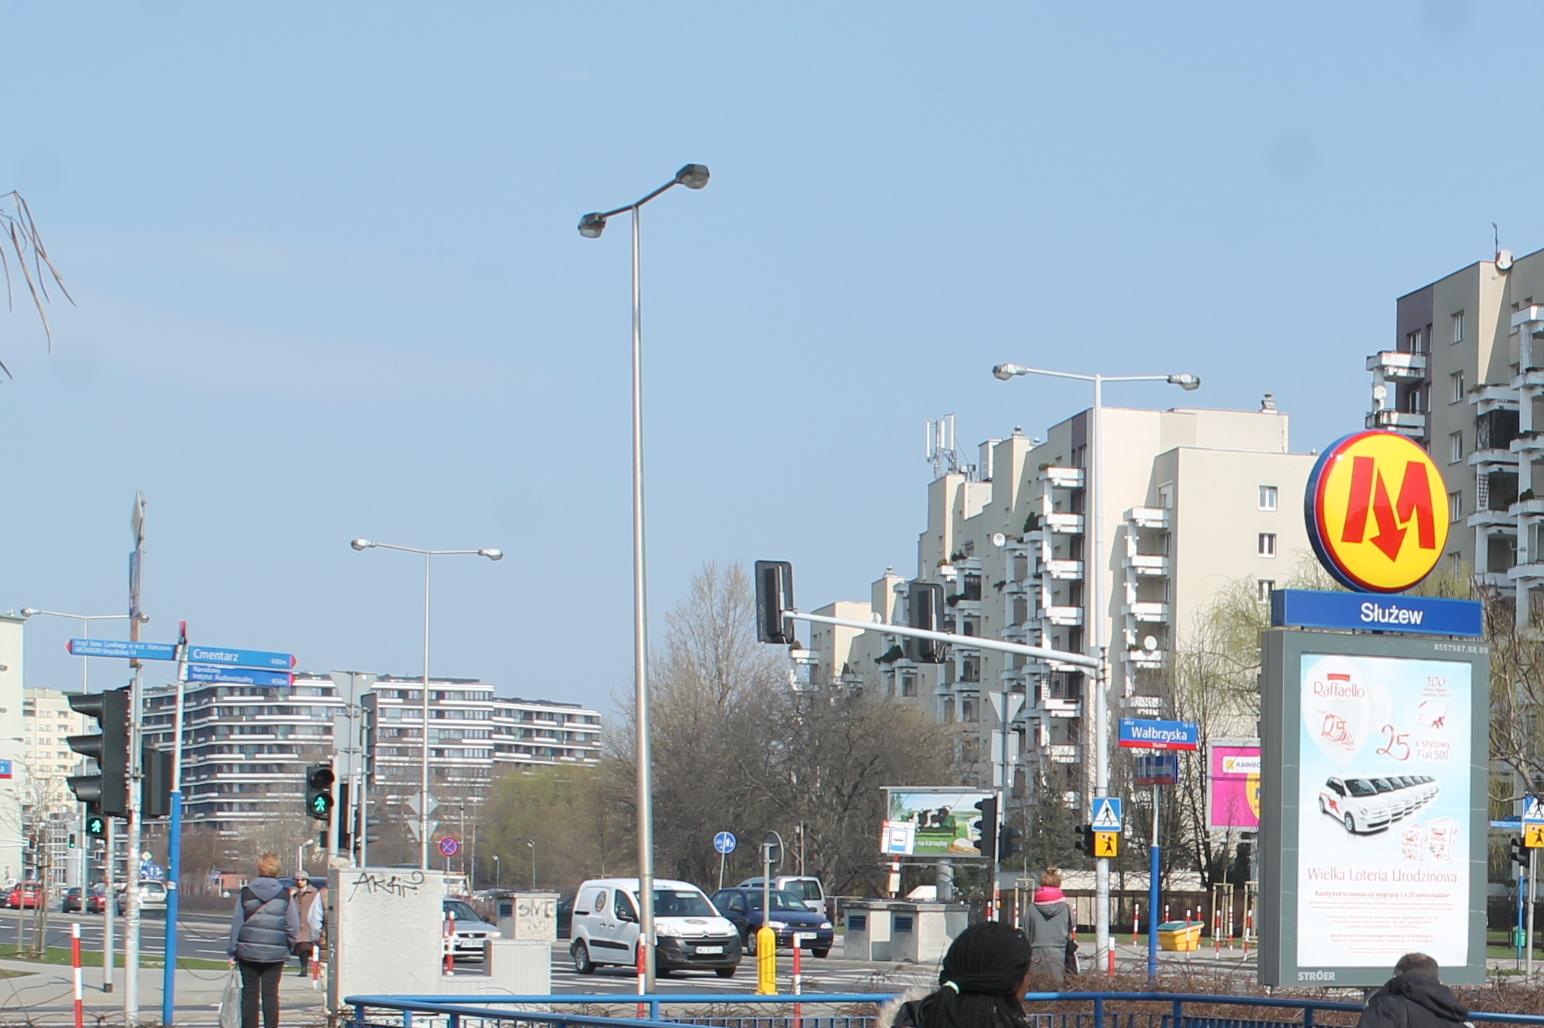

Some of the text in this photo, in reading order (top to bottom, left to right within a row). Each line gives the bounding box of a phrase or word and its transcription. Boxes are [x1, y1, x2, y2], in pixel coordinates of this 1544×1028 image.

[1340, 455, 1436, 564] M
[1360, 602, 1424, 626] Służew
[193, 648, 239, 662] Cmentarz
[1313, 680, 1366, 698] Raffaello
[1131, 726, 1188, 743] Wałbrzyska
[1375, 723, 1411, 761] 25
[1307, 866, 1458, 884] Wielka Loteria Urodzinowa
[1297, 970, 1336, 982] STRÖER
